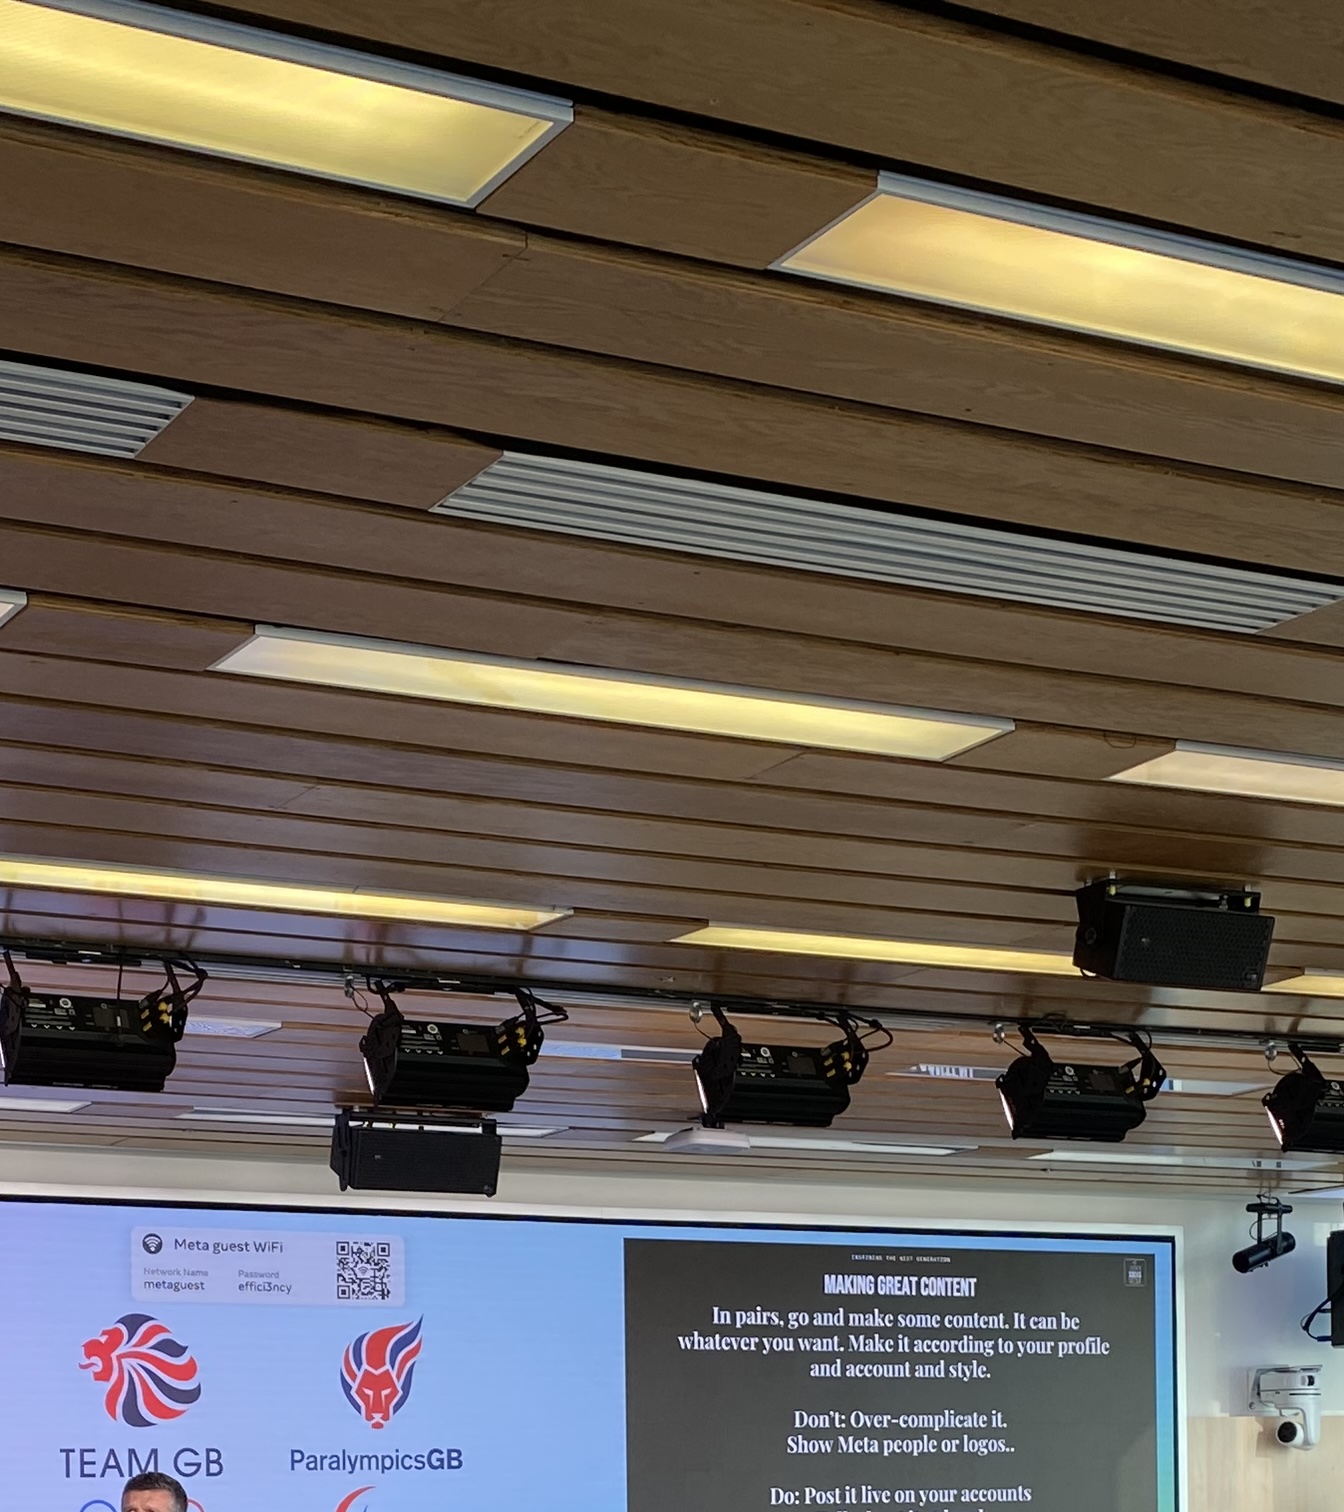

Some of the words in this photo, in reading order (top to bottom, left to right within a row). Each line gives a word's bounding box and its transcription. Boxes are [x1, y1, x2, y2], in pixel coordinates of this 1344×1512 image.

[174, 1238, 209, 1252] Meta
[212, 1241, 250, 1255] guest
[253, 1241, 283, 1253] WiFi
[143, 1267, 182, 1277] Network
[183, 1268, 209, 1277] Name
[238, 1269, 280, 1279] Password
[143, 1280, 205, 1293] metaguest
[238, 1280, 293, 1295] effici3ncy
[824, 1274, 875, 1295] MAKING
[877, 1275, 919, 1296] GREAT
[920, 1276, 977, 1297] CONTENT
[712, 1306, 732, 1325] In
[735, 1305, 785, 1329] pairs,
[787, 1311, 810, 1330] go
[812, 1307, 845, 1327] and
[848, 1308, 894, 1328] make
[897, 1313, 941, 1328] some
[943, 1312, 1010, 1330] content.
[1013, 1312, 1027, 1330] It
[1029, 1316, 1058, 1330] can
[1060, 1311, 1080, 1331] be
[677, 1330, 760, 1352] whatever
[761, 1337, 795, 1355] you
[797, 1335, 845, 1352] want.
[848, 1333, 895, 1353] Make
[897, 1333, 911, 1353] it
[913, 1334, 995, 1358] according
[997, 1337, 1014, 1354] to
[1016, 1340, 1055, 1358] your
[1057, 1336, 1110, 1358] profile
[809, 1358, 842, 1378] and
[845, 1361, 912, 1378] account
[914, 1359, 946, 1378] and
[948, 1359, 991, 1382] style.
[794, 1410, 846, 1429] Don't:
[849, 1409, 988, 1432] Over-complicate
[991, 1409, 1008, 1429] it.
[786, 1434, 834, 1454] Show
[837, 1435, 880, 1454] Meta
[882, 1434, 938, 1457] people
[940, 1439, 960, 1453] or
[963, 1434, 1015, 1457] logos..
[59, 1448, 159, 1479] TEAM
[172, 1447, 224, 1478] GB
[289, 1448, 464, 1475] ParalympicsGB
[770, 1487, 800, 1506] Do:
[804, 1486, 842, 1505] Post
[844, 1485, 858, 1505] it
[860, 1484, 891, 1504] live
[894, 1489, 916, 1504] on
[918, 1489, 958, 1507] your
[960, 1485, 1032, 1503] accounts
